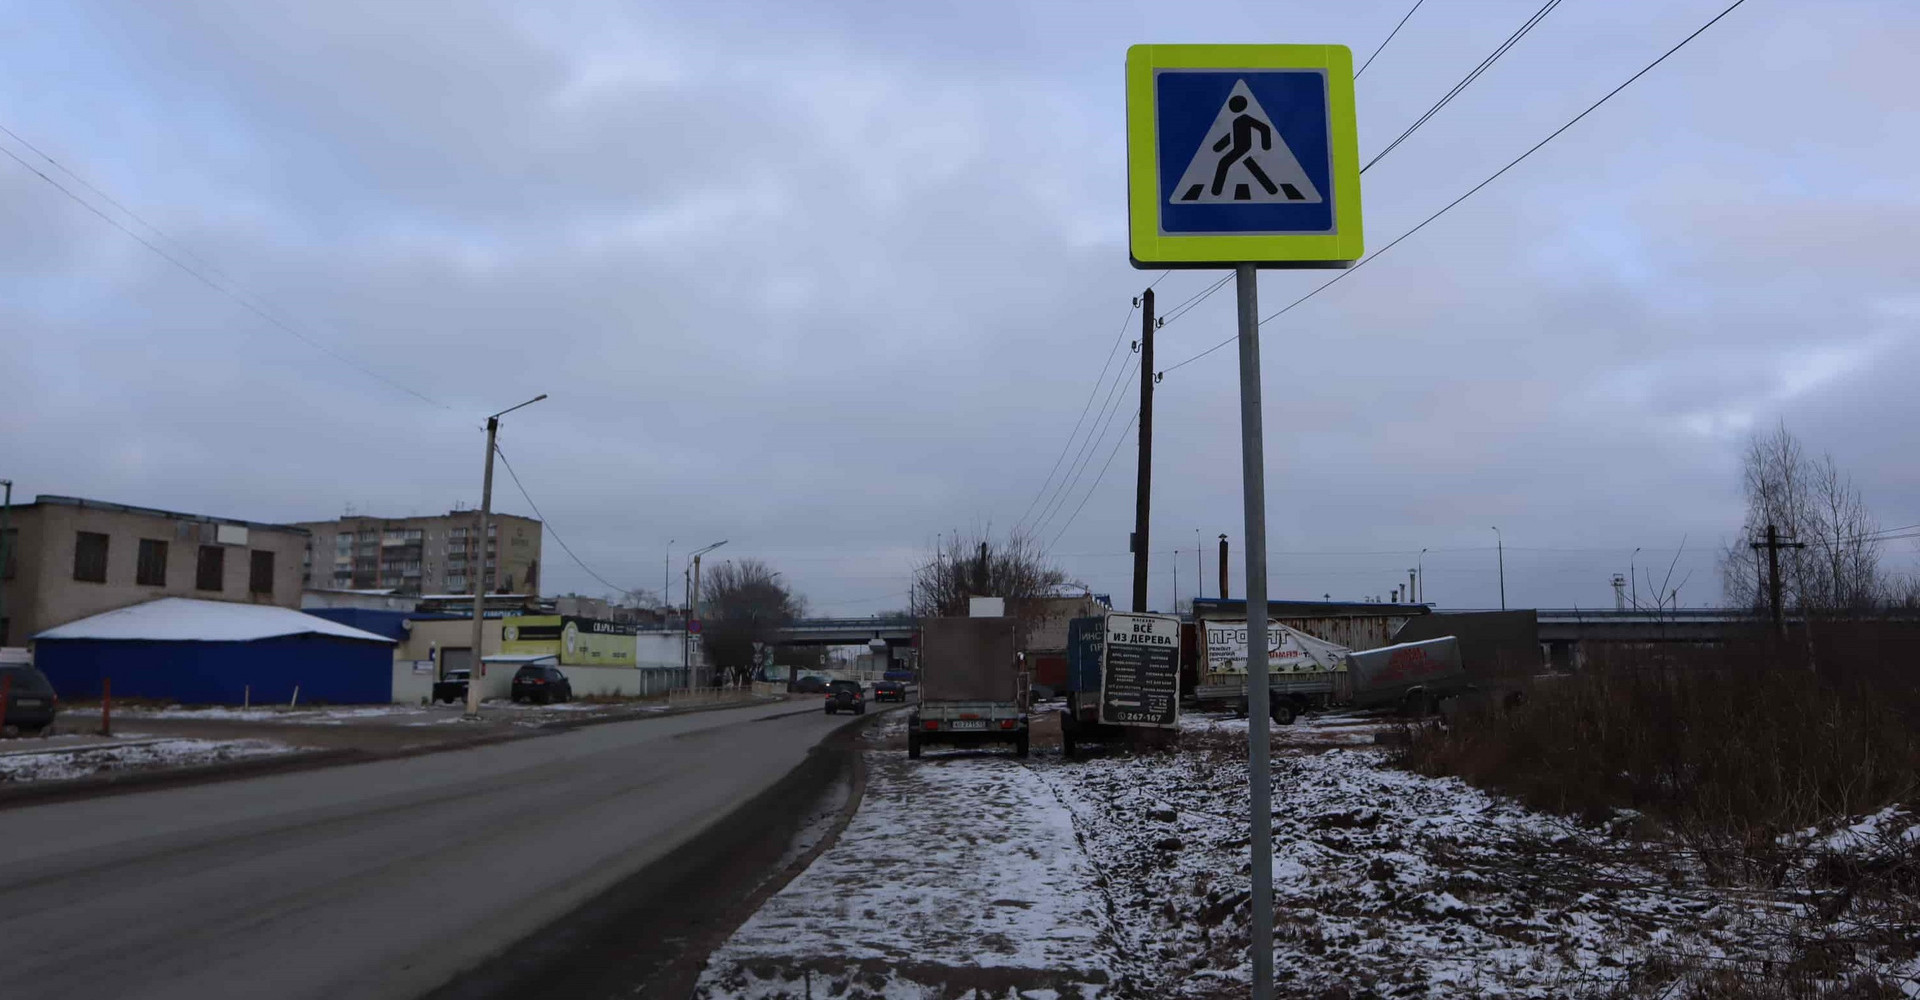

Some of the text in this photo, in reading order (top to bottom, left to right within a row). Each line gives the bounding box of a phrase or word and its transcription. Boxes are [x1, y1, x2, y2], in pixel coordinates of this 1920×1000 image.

[1133, 622, 1153, 633] ВСЁ
[1113, 632, 1172, 645] ИЗ ДЕРЕВА
[1208, 629, 1290, 644] ПРОАТ
[1127, 712, 1161, 722] 267-167
